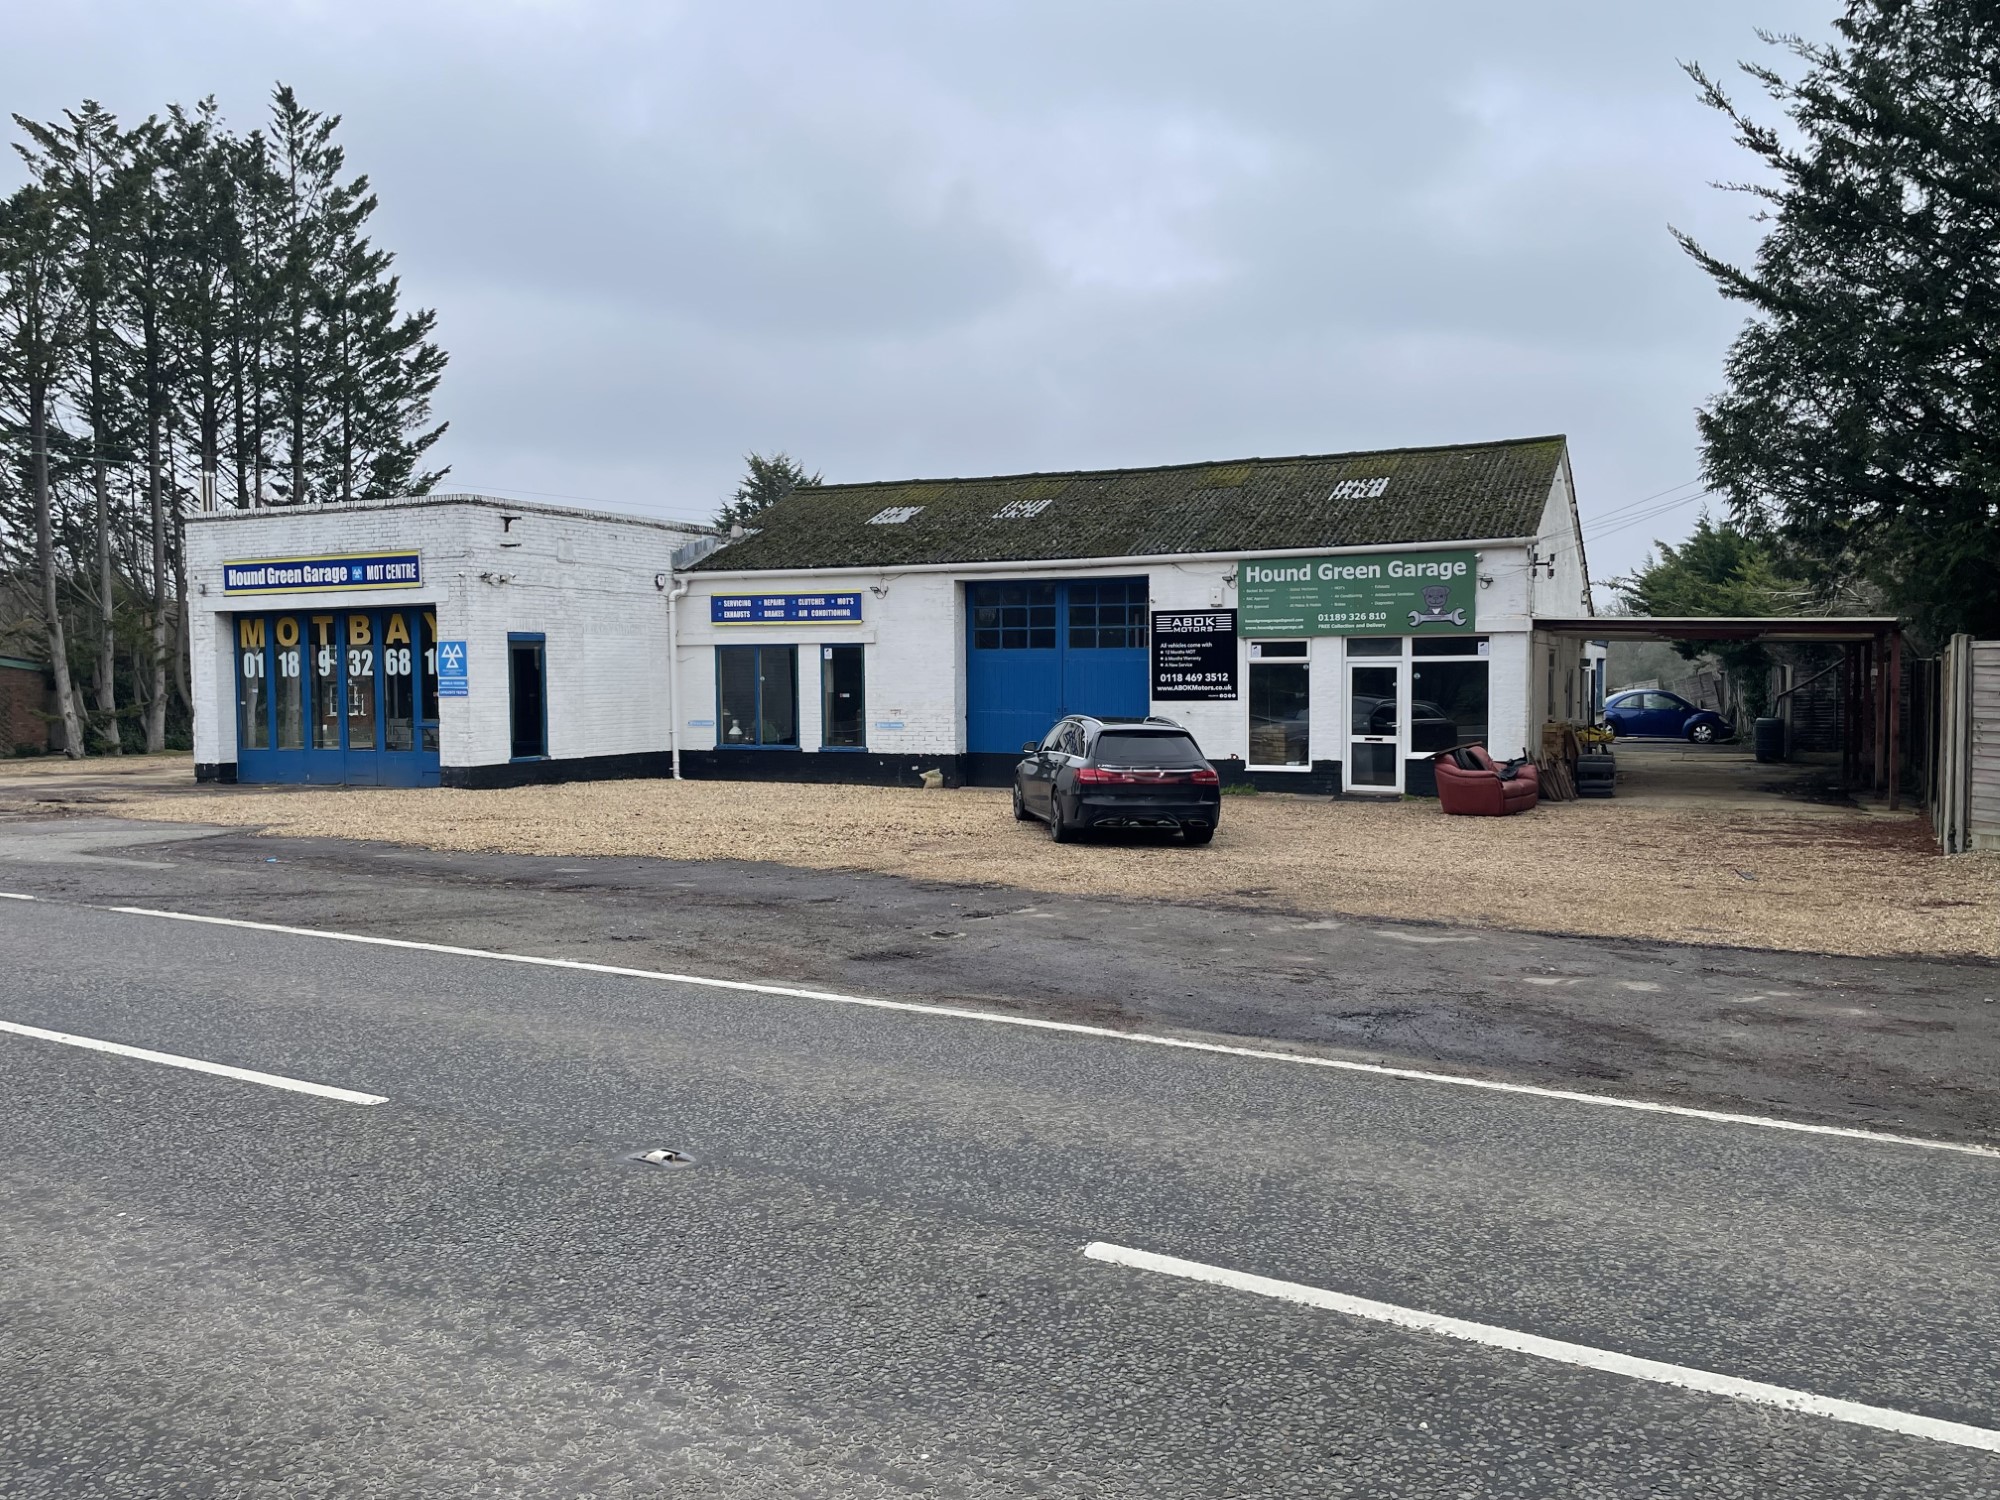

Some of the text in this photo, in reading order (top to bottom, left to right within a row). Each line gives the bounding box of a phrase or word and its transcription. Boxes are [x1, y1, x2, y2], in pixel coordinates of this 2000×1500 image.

[228, 565, 348, 586] Hound Green Garage
[366, 563, 416, 581] MOT CENTRE
[1246, 560, 1467, 583] Hound Green Garage
[798, 598, 825, 606] CLUTCHES
[837, 597, 855, 605] MOT'S
[723, 608, 851, 618] EXHAUSTS BRAKES AIR CONDITIONING
[1318, 612, 1387, 621] 01189 326 810
[1172, 617, 1215, 626] ABOK
[243, 652, 265, 678] 01
[278, 651, 300, 677] 18
[349, 650, 373, 676] 32
[385, 648, 411, 676] 68
[1160, 672, 1229, 682] 0118 469 3512
